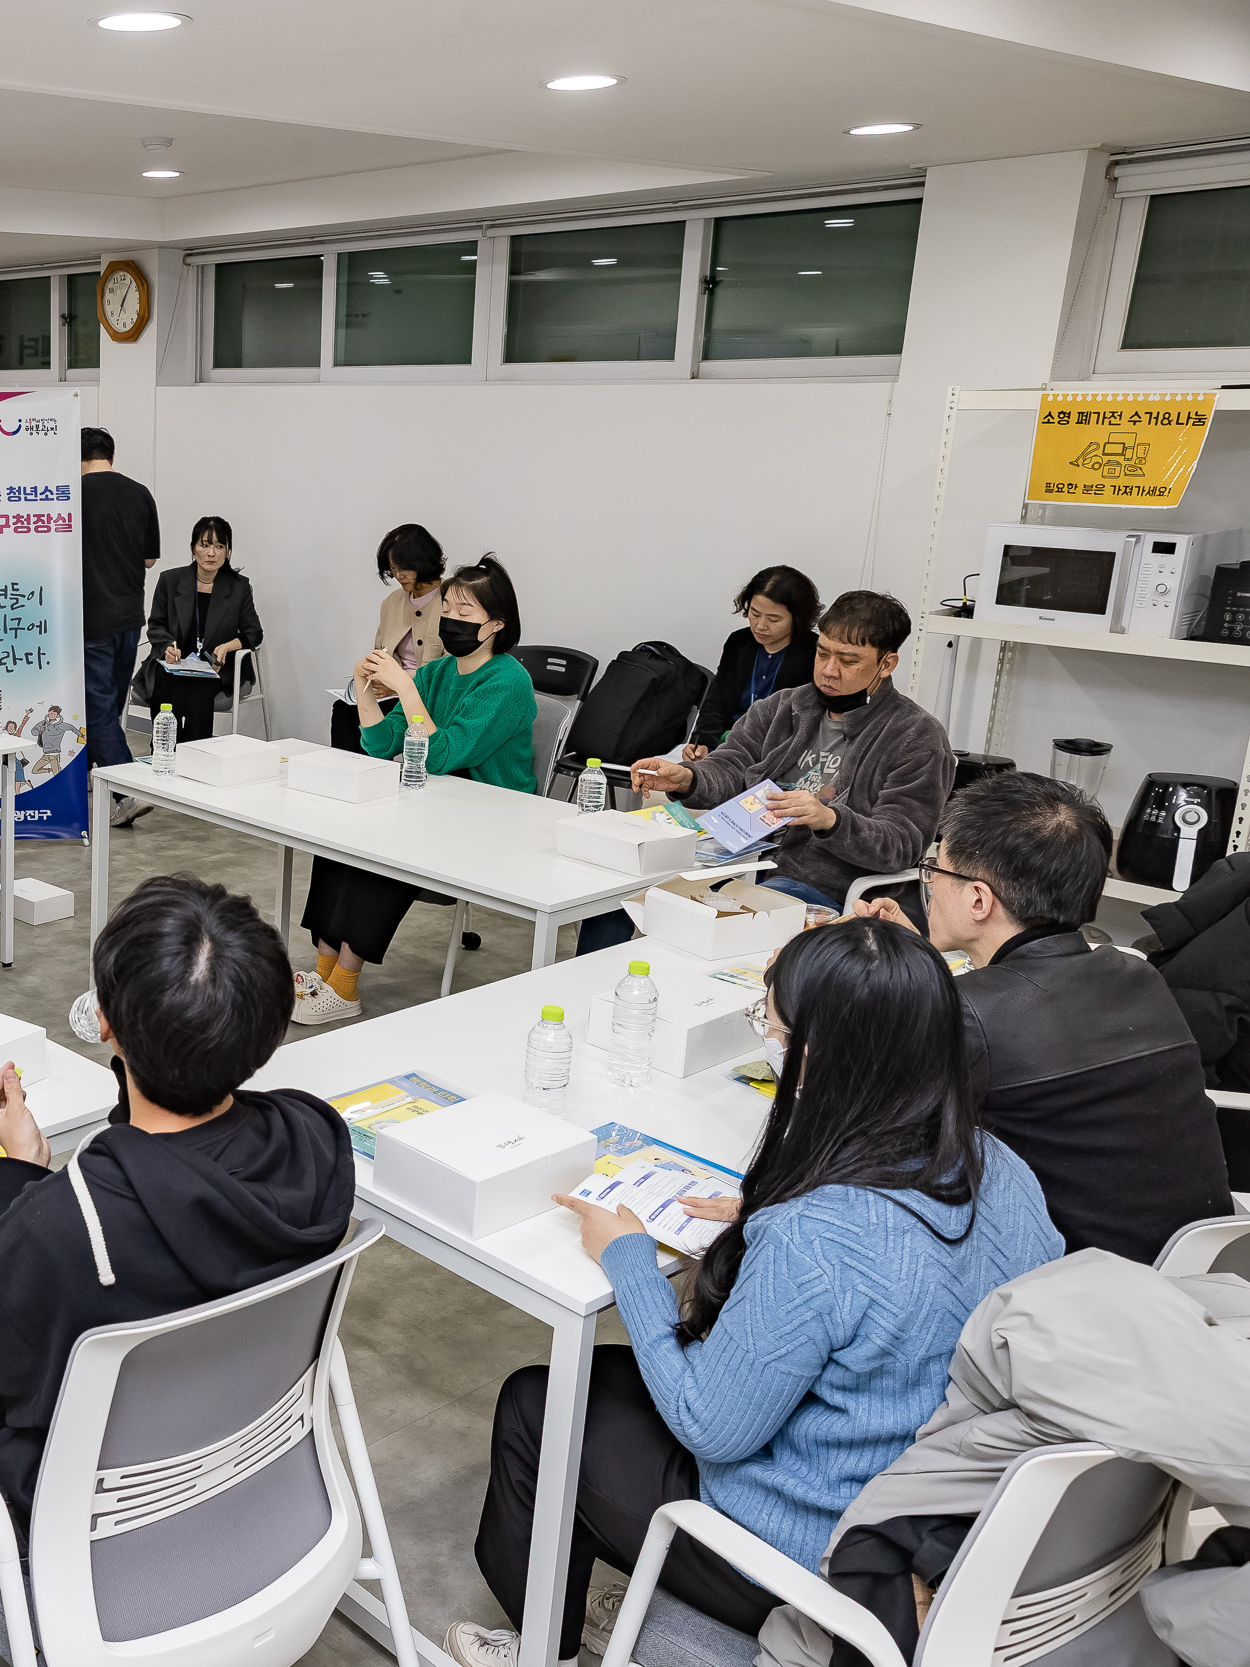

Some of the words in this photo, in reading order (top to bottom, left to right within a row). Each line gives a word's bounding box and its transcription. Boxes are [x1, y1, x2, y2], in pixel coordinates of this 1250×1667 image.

[1041, 411, 1072, 426] 소형
[1075, 411, 1122, 426] 폐가전
[1128, 411, 1208, 426] 수거&나눔
[25, 424, 57, 436] 행복광진
[6, 485, 71, 502] 청년소통
[1044, 483, 1078, 494] 필요한
[1082, 484, 1105, 495] 분은
[1110, 485, 1172, 497] 가져가세요!
[14, 809, 52, 822] 광진구
